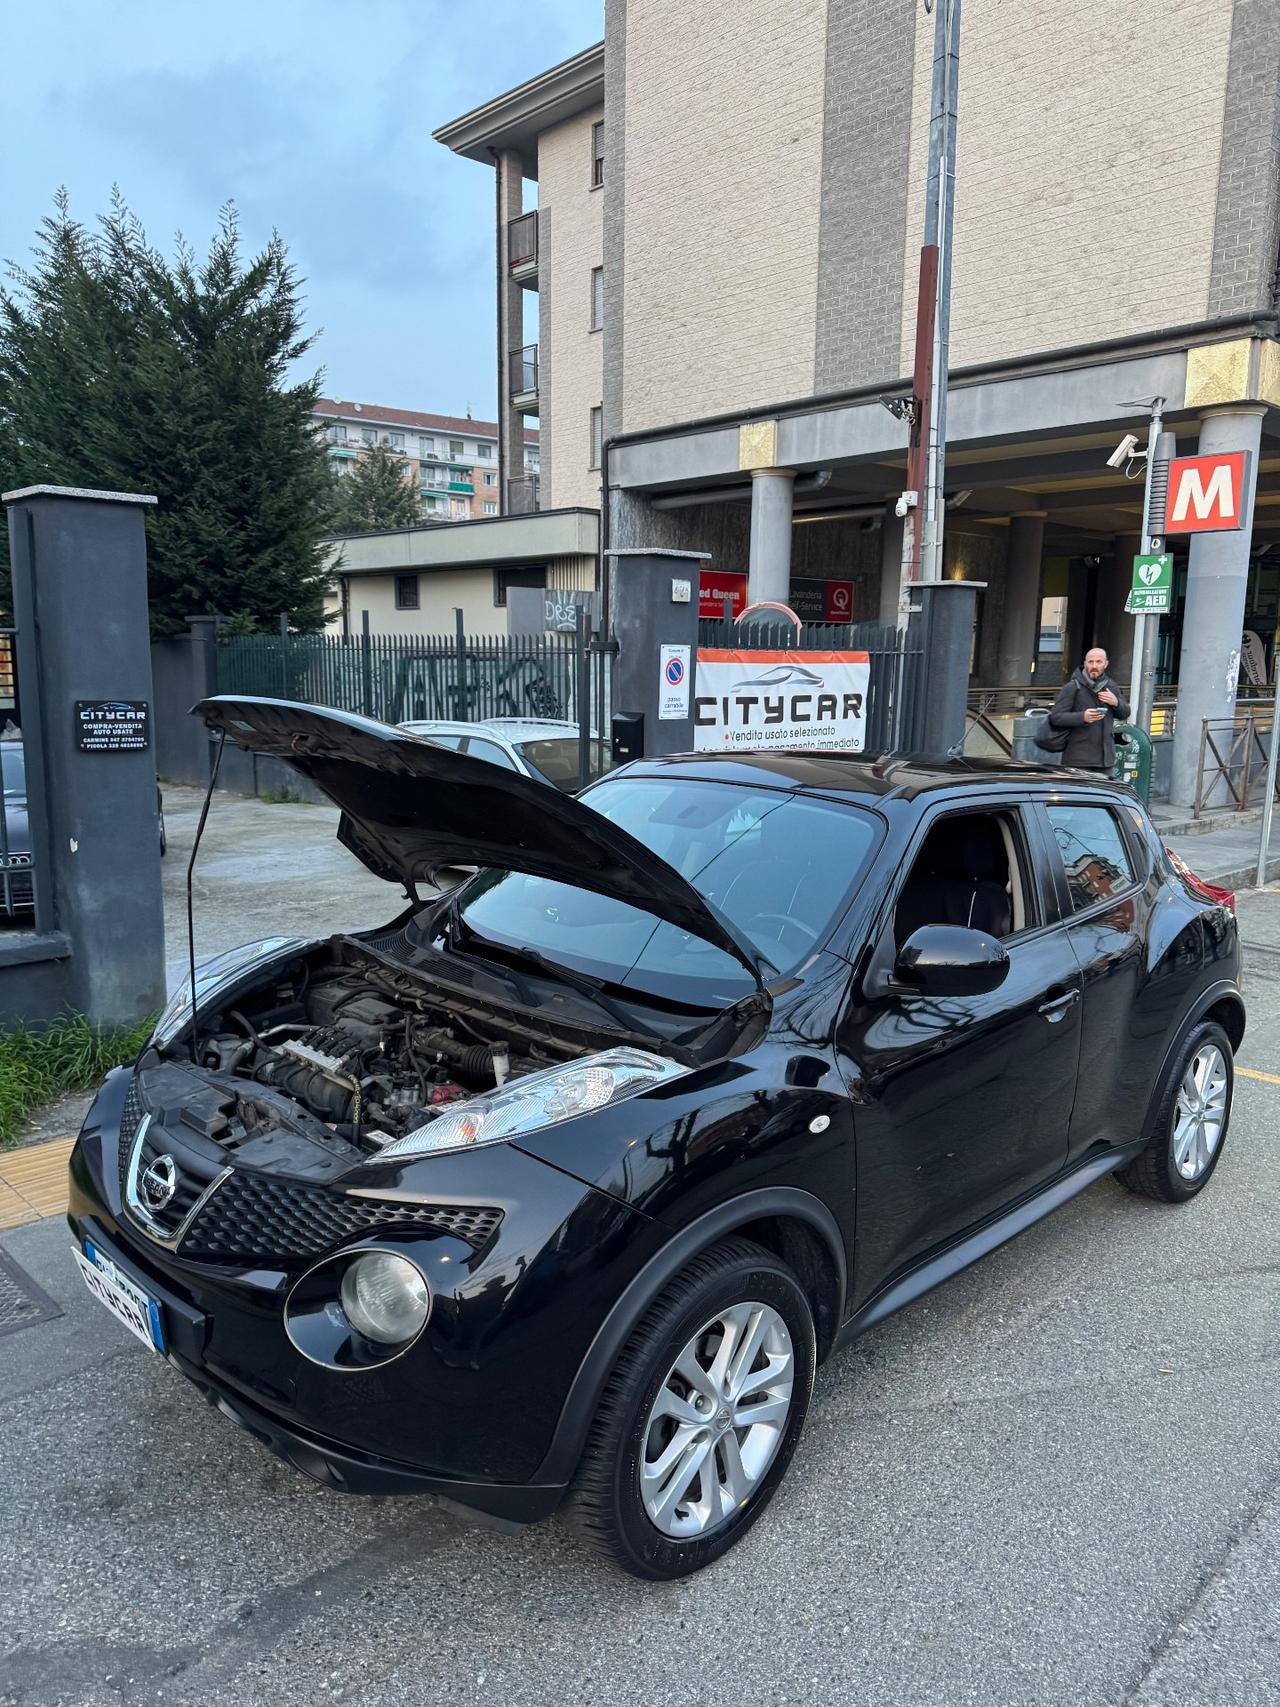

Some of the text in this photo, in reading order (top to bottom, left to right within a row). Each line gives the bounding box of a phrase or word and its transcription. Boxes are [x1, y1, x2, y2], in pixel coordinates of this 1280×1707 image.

[1171, 465, 1235, 521] M
[699, 588, 740, 600] ed Queen
[790, 601, 822, 611] elf-Service
[1145, 595, 1167, 606] AED
[80, 711, 146, 720] CITYCAR
[694, 693, 862, 726] CITYCAR
[730, 726, 835, 742] Vendita usato selezionato
[817, 738, 859, 750] immediato
[81, 1264, 148, 1338] CITYCAR
